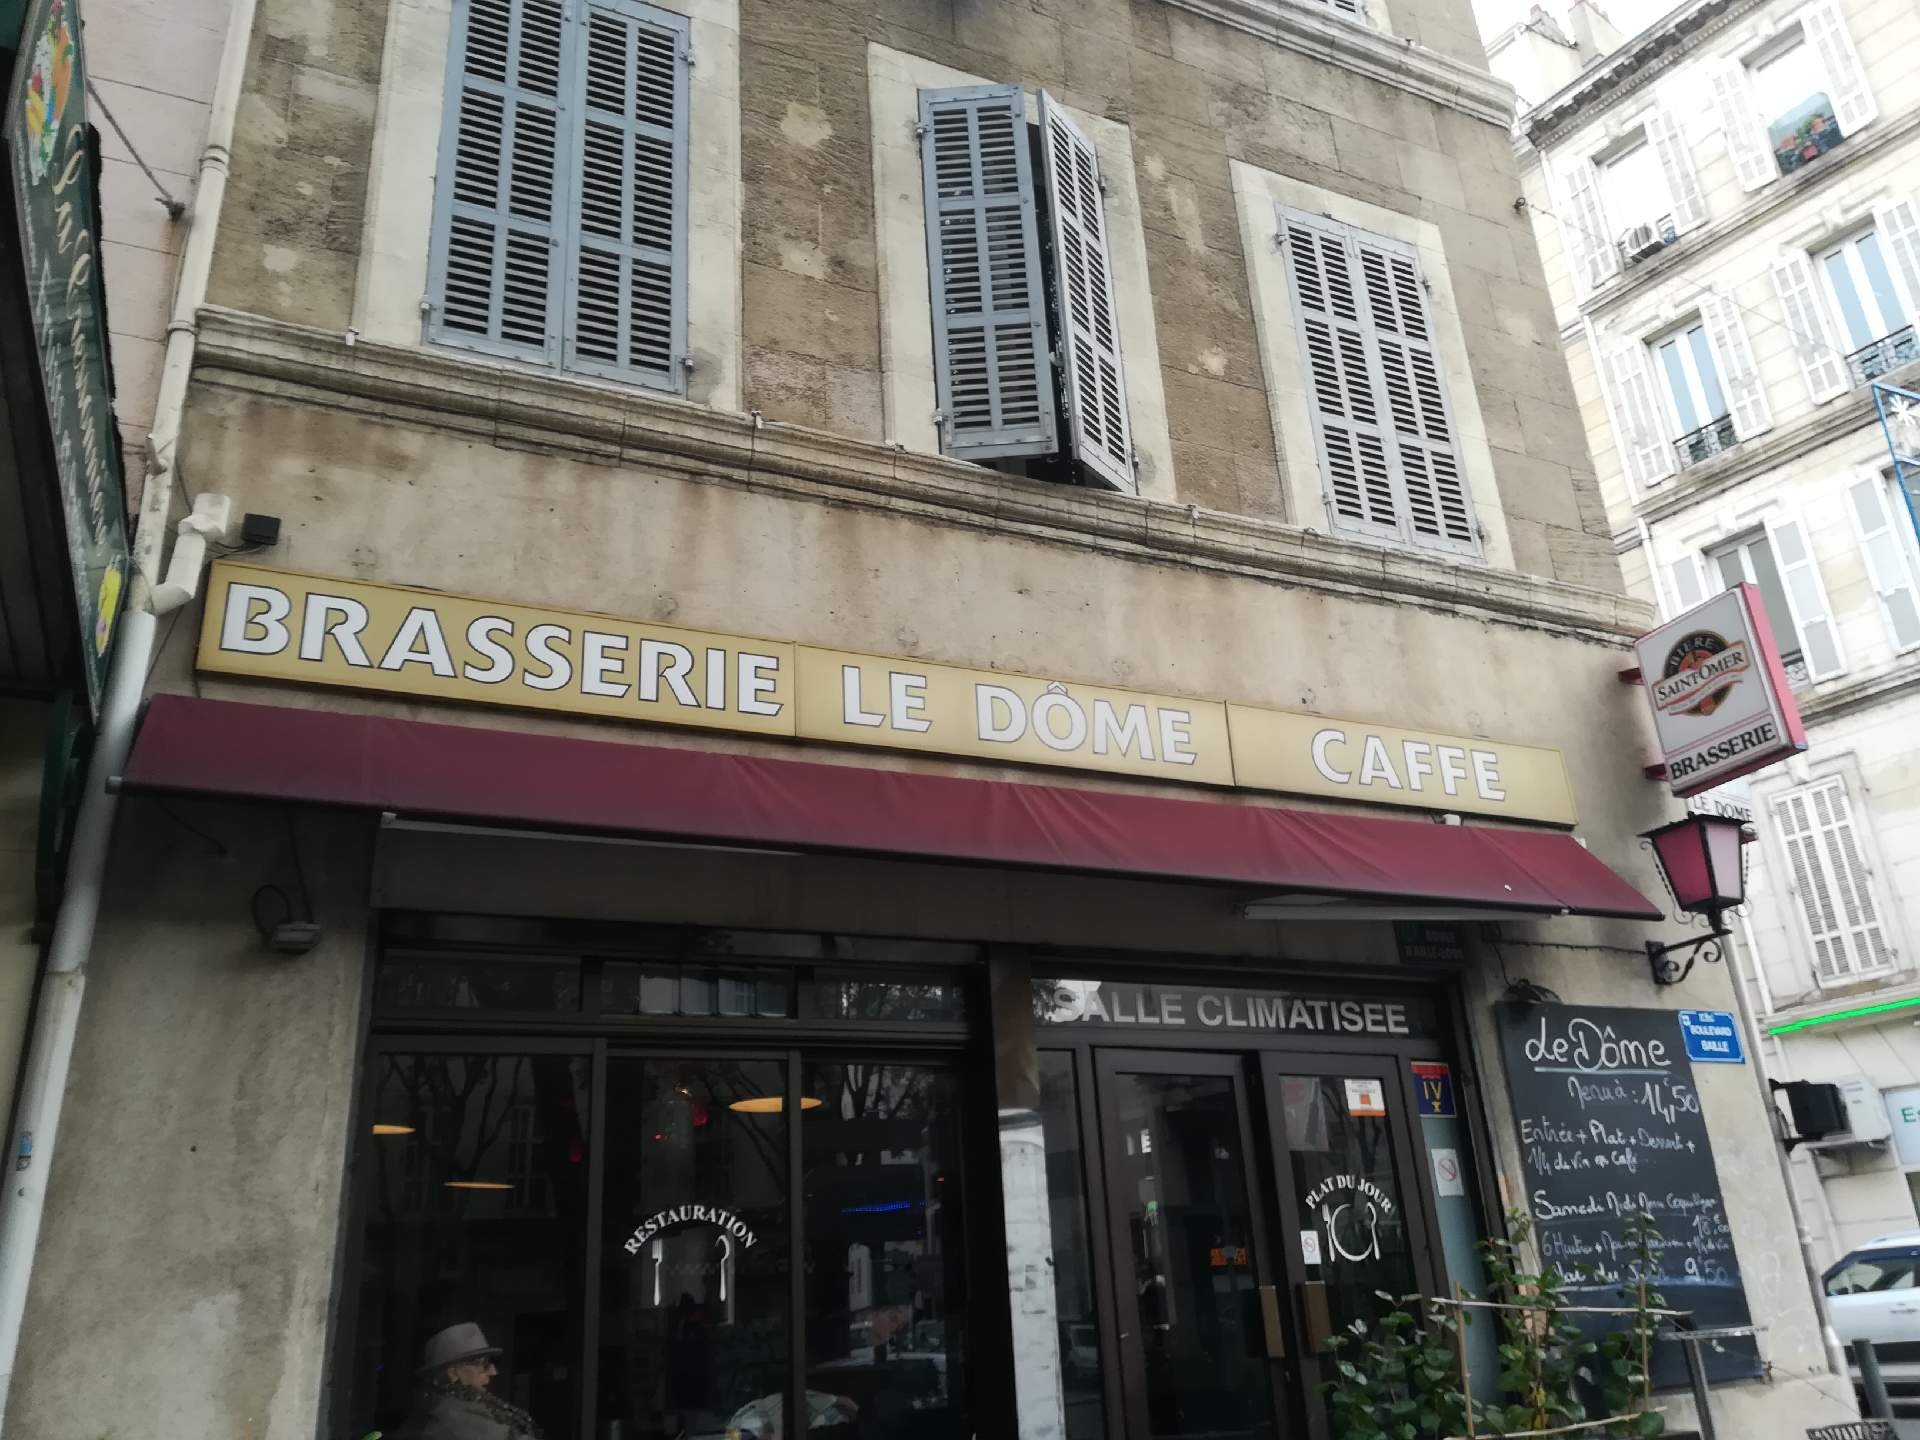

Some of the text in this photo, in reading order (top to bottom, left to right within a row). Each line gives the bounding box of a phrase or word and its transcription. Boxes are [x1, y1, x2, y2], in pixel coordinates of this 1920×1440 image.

[219, 582, 784, 717] BRASSERIE
[841, 664, 1198, 767] LE DÔME
[1311, 728, 1507, 801] CAFFE
[1670, 722, 1777, 780] BRASSERIE
[1052, 986, 1411, 1035] SALLE CLIMATISEE
[1568, 1018, 1672, 1072] Dôme
[1305, 1174, 1392, 1213] PLAT DU JOUR
[624, 1204, 758, 1256] RESTAURATION
